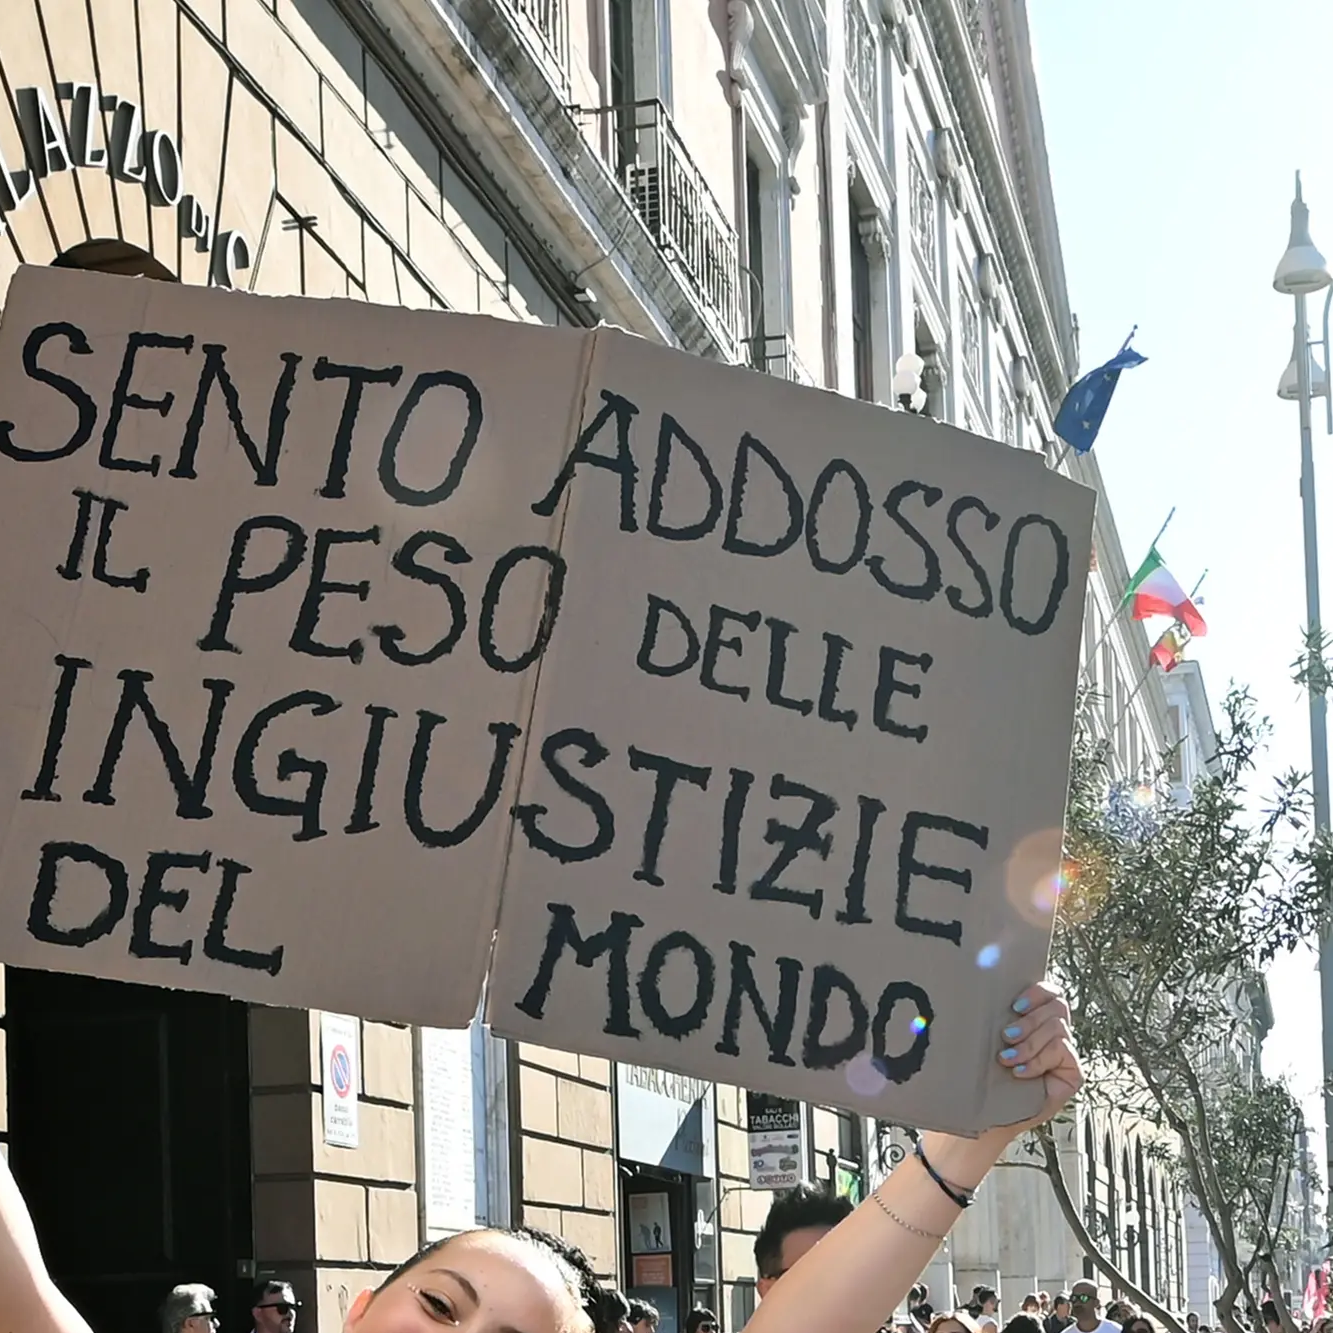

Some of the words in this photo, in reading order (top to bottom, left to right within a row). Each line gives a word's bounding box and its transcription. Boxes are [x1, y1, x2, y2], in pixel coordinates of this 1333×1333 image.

[57, 489, 149, 591] IL
[197, 514, 568, 672] PESO
[634, 593, 933, 743] DELLE
[532, 390, 1068, 636] ADDOSSO
[20, 654, 989, 946] INGIUSTIZIE
[27, 841, 283, 976] DEL
[515, 903, 934, 1083] MONDO
[750, 1113, 799, 1124] TABACCHI
